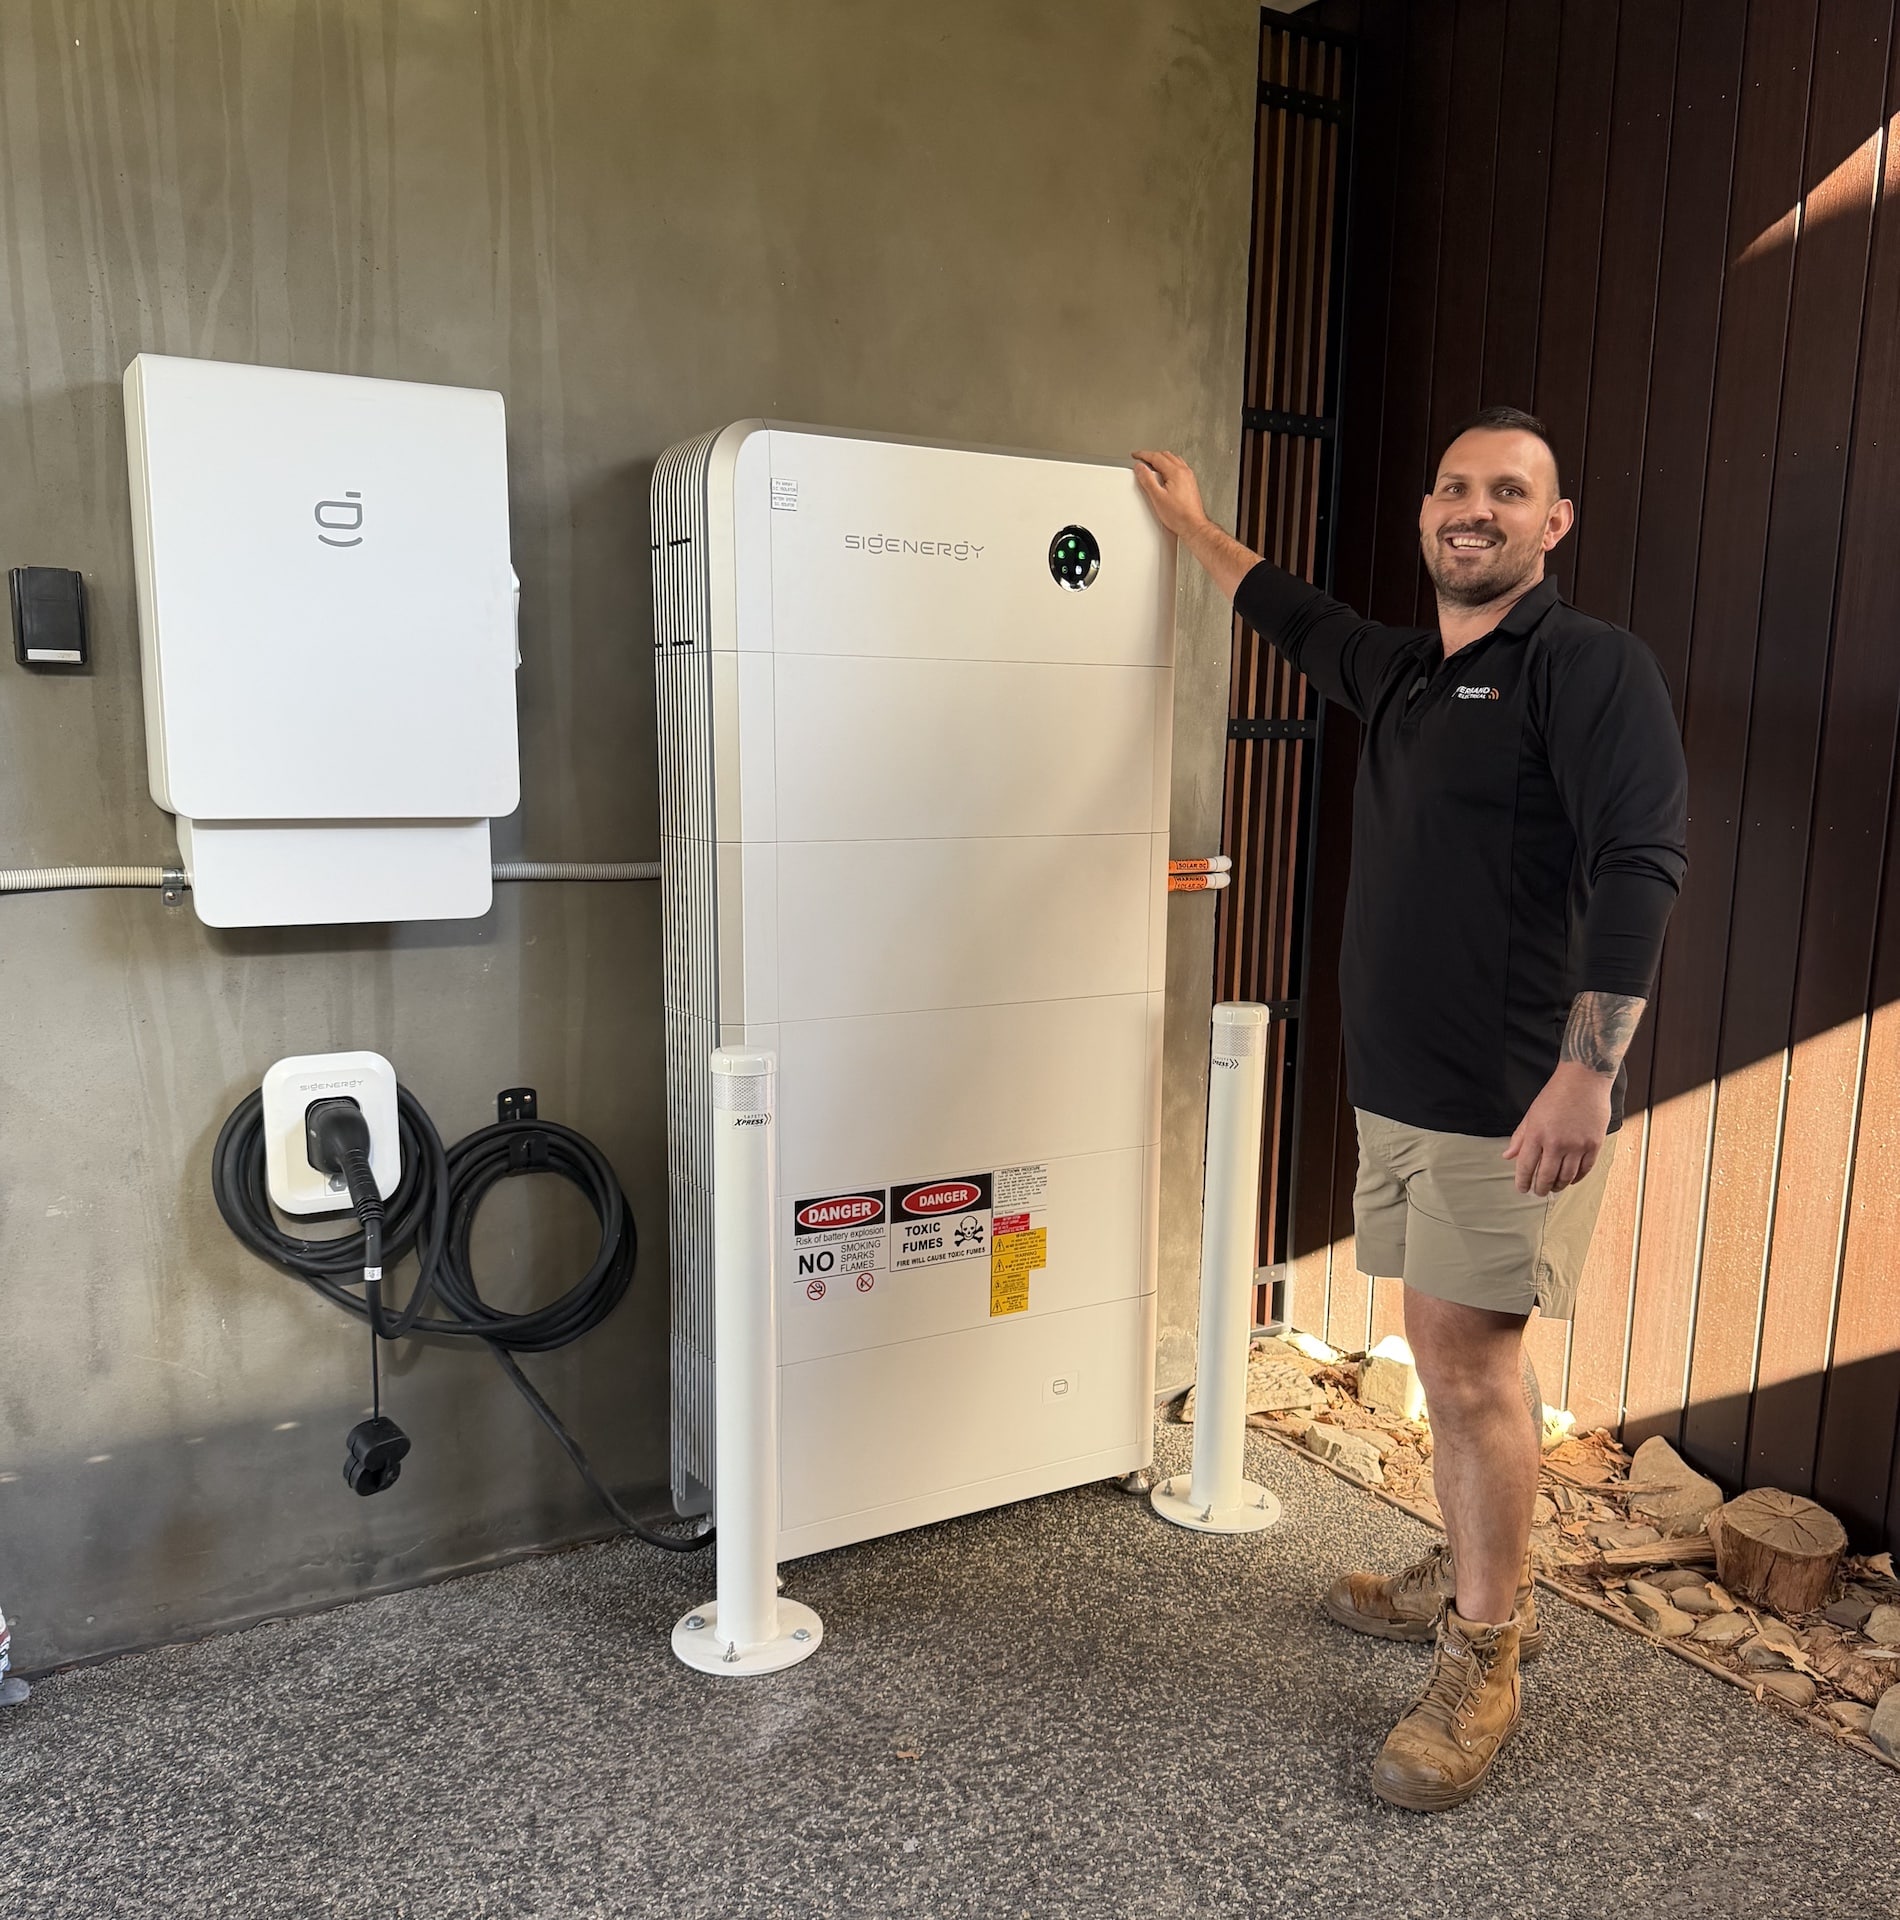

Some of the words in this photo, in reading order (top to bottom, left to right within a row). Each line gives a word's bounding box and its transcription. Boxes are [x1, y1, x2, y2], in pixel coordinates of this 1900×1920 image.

[919, 1189, 968, 1207] DANGER
[808, 1201, 872, 1224] DANGER
[795, 1236, 813, 1246] Risk
[814, 1234, 822, 1243] of
[823, 1231, 849, 1242] battery
[850, 1226, 884, 1239] explosion
[904, 1222, 941, 1237] TOXIC
[840, 1239, 881, 1253] SMOKING
[902, 1237, 943, 1253] FUMES
[799, 1251, 835, 1275] NO
[840, 1250, 875, 1263] SPARKS
[911, 1257, 925, 1265] WILL
[927, 1253, 946, 1262] CAUSE
[947, 1250, 965, 1259] TOXIC
[966, 1246, 986, 1255] FUMES
[840, 1260, 875, 1272] FLAMES
